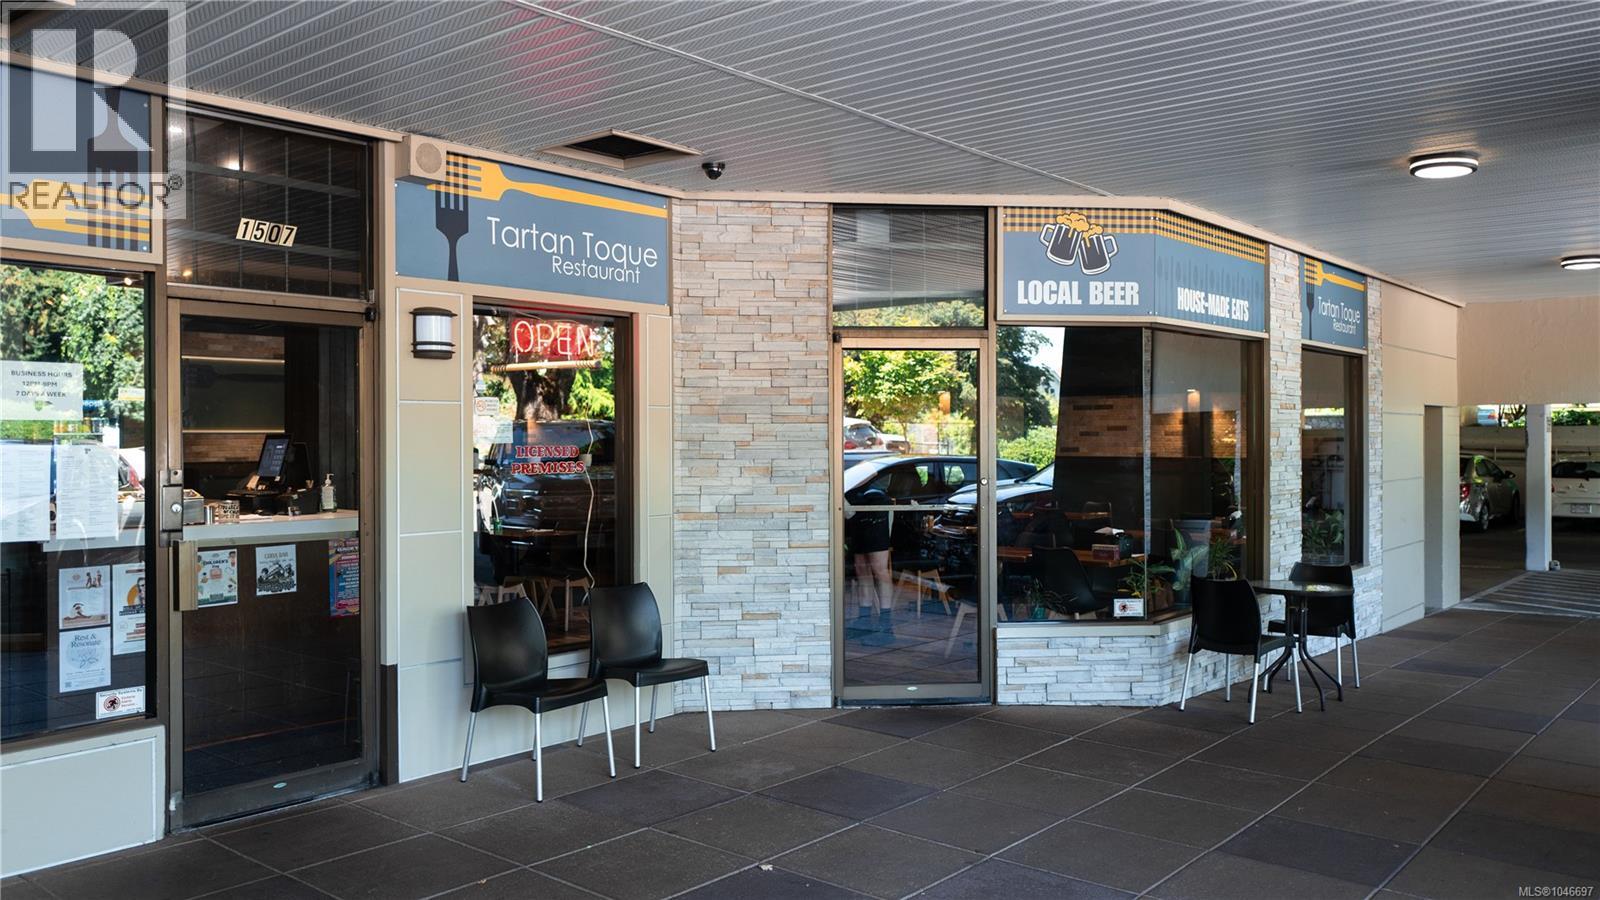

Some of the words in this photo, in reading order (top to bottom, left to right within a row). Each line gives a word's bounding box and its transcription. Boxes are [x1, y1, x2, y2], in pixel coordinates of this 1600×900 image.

[241, 220, 296, 245] 1507
[486, 216, 575, 256] Tartan
[582, 231, 659, 270] Toque
[551, 255, 641, 284] Restaurant
[1017, 279, 1082, 305] LOCAL
[1089, 280, 1139, 306] BEER
[1177, 286, 1230, 319] HOUSE-MADE
[1231, 297, 1249, 322] EATS
[1317, 296, 1340, 320] Tartan
[1340, 301, 1361, 325] Toque
[513, 320, 594, 358] OPEN
[1332, 318, 1357, 336] Restaurant
[515, 445, 580, 458] LICENSED
[511, 461, 586, 475] PREMISES
